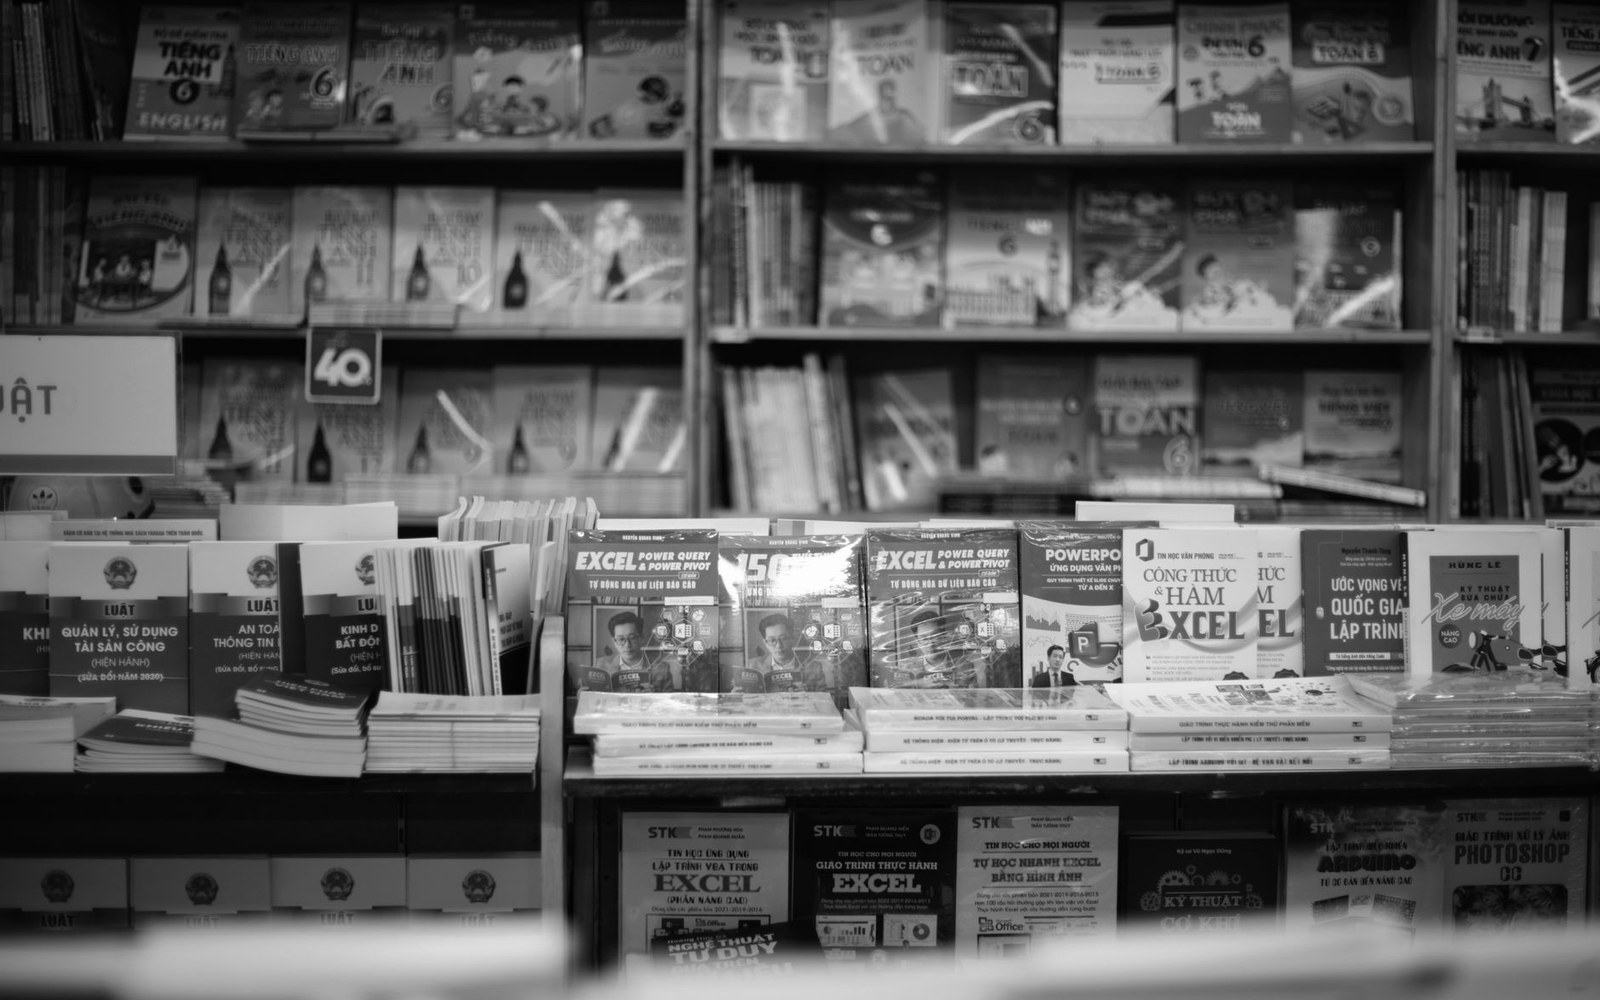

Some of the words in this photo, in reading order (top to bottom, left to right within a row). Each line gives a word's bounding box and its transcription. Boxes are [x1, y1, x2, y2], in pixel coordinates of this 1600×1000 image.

[159, 39, 221, 60] TIẾNG
[1248, 34, 1265, 58] 6
[1489, 44, 1520, 60] ANH
[164, 61, 211, 78] ANH
[310, 65, 336, 100] 6
[138, 111, 228, 131] ENGLISH
[0, 376, 58, 424] ẬT
[1101, 407, 1195, 435] TOÁN
[575, 551, 637, 571] EXCEL
[638, 552, 674, 561] POWER
[677, 552, 711, 561] QUERY
[875, 550, 937, 570] EXCEL
[938, 549, 973, 559] POWER
[977, 548, 1010, 558] QUERY
[1045, 548, 1121, 562] POWERPO
[1157, 552, 1167, 560] TIN
[1167, 552, 1180, 560] HỌC
[1180, 551, 1193, 560] VĂN
[1194, 551, 1214, 560] PHÒNG
[638, 563, 646, 571] &
[648, 562, 682, 571] POWER
[683, 562, 711, 571] PIVOT
[938, 561, 946, 569] &
[948, 560, 981, 569] POWER
[983, 559, 1011, 568] PIVOT
[1050, 563, 1068, 572] ỨNG
[1070, 564, 1093, 574] DỤNG
[1094, 563, 1112, 572] VĂN
[1143, 566, 1188, 583] CÔNG
[1191, 566, 1237, 583] THỨC
[600, 580, 619, 590] ĐỘNG
[650, 580, 664, 590] LIỆU
[666, 579, 680, 589] BÁO
[682, 579, 697, 589] CÁO
[1357, 578, 1388, 593] VỌNG
[1154, 586, 1164, 596] &
[1165, 583, 1225, 606] HÀM
[104, 602, 136, 618] LUẬT
[1331, 593, 1375, 616] QUỐC
[1379, 598, 1403, 616] GIA
[1134, 598, 1245, 642] EXCEL
[1470, 595, 1525, 631] máy
[61, 624, 99, 638] QUẢN
[123, 623, 140, 638] SỬ
[142, 626, 178, 640] DỤNG
[238, 624, 256, 635] AN
[341, 624, 368, 635] KINH
[1330, 619, 1360, 642] LẬP
[1441, 629, 1460, 637] NÂNG
[74, 640, 94, 653] TÀI
[97, 639, 123, 653] SẢN
[126, 641, 166, 653] CÔNG
[213, 635, 254, 648] THÔNG
[256, 638, 274, 648] TIN
[335, 634, 356, 649] BẤT
[91, 657, 116, 669] (HIỆN
[118, 657, 150, 668] HÀNH)
[619, 672, 641, 682] EXCEL
[972, 816, 1000, 829] STK
[648, 826, 677, 839] STK
[813, 824, 843, 837] STK
[1455, 830, 1479, 842] GIÁO
[1483, 829, 1513, 841] TRÌNH
[985, 841, 999, 849] TIN
[1001, 841, 1020, 850] HỌC
[1021, 841, 1041, 849] CHO
[1042, 841, 1060, 850] MỌI
[1061, 839, 1090, 849] NGƯỜI
[667, 849, 683, 858] TIN
[685, 848, 702, 859] HỌC
[726, 849, 750, 859] DỤNG
[1454, 842, 1570, 865] PHOTOSHOP
[652, 860, 671, 872] LẬP
[675, 860, 702, 871] TRÌNH
[705, 862, 726, 871] VBA
[729, 862, 759, 871] TRONG
[816, 860, 843, 870] GIÁO
[845, 860, 876, 870] TRÌNH
[878, 861, 907, 871] THỰC
[908, 860, 938, 870] HÀNH
[972, 857, 990, 870] TỰ
[991, 857, 1017, 869] HỌC
[1019, 857, 1060, 868] NHANH
[1062, 857, 1102, 867] EXCEL
[991, 869, 1024, 883] BẰNG
[1026, 870, 1055, 882] HÌNH
[1058, 869, 1083, 882] ẢNH
[1500, 866, 1522, 881] CC
[653, 873, 762, 893] EXCEL
[832, 873, 922, 893] EXCEL
[697, 894, 722, 905] NÂNG
[1164, 894, 1187, 908] KỸ
[1189, 893, 1242, 909] THUẬT
[40, 913, 75, 930] LUẬT
[995, 921, 1024, 931] Office
[668, 939, 715, 952] NGHỆ
[717, 932, 775, 947] THUẬT
[716, 941, 778, 961] DUY
